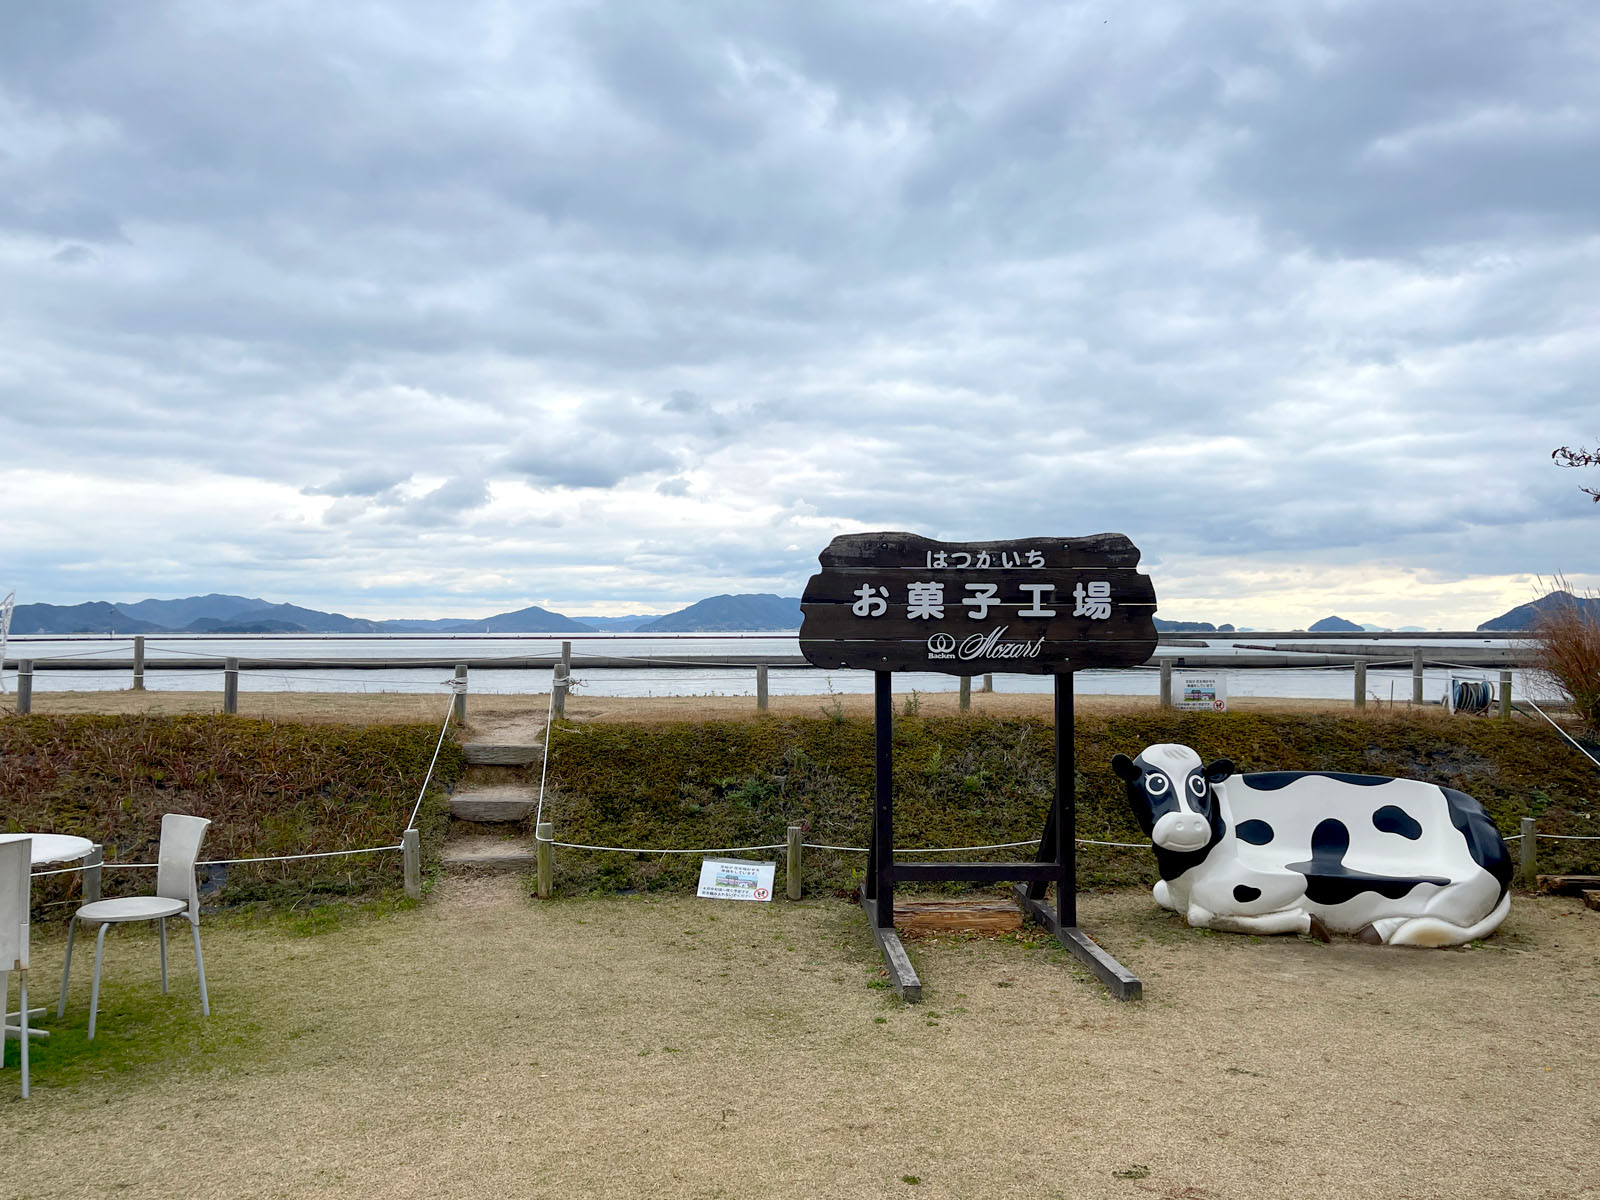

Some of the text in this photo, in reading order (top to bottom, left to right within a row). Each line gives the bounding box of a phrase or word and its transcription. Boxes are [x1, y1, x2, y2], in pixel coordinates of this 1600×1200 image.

[926, 549, 1046, 569] はつかいち
[852, 581, 1112, 620] お菓子工場
[927, 652, 956, 660] Backen
[958, 625, 1045, 660] Mozart
